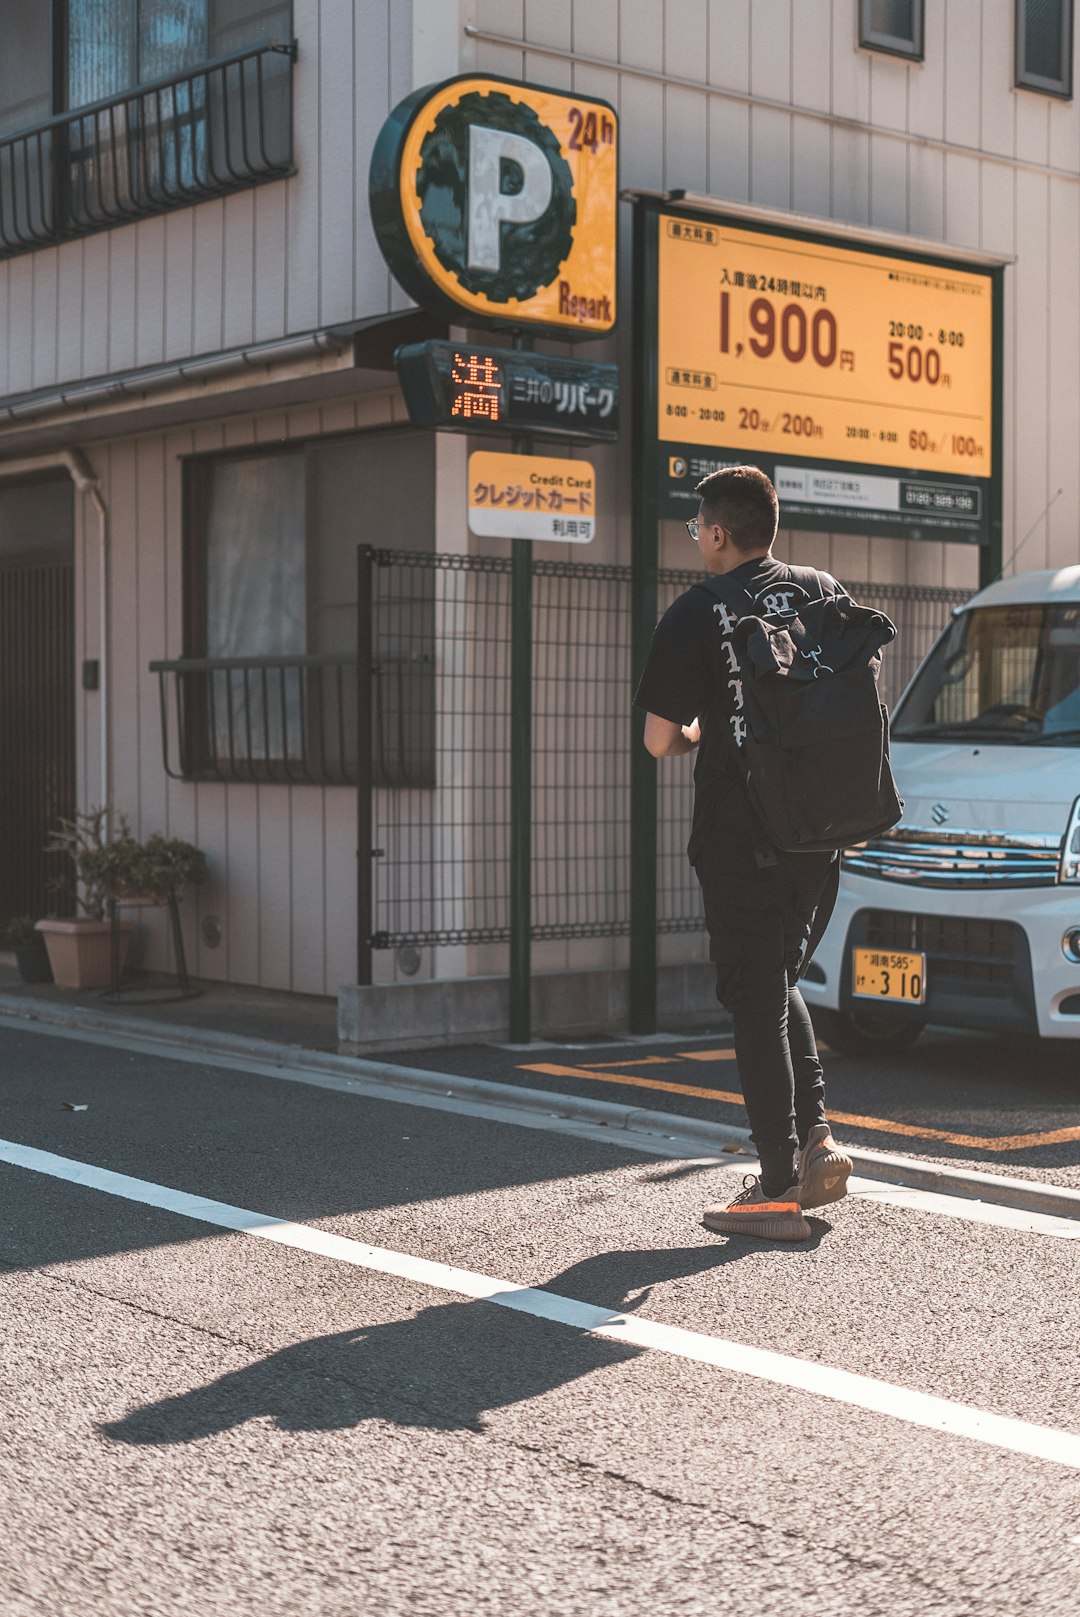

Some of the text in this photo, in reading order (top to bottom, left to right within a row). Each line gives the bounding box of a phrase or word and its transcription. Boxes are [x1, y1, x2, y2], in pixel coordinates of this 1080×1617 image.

[568, 107, 614, 154] 24h
[468, 124, 553, 272] P
[558, 280, 612, 323] Repark
[719, 267, 827, 301] 入庫後24時間以内
[451, 353, 502, 421] 満
[513, 376, 614, 418] 三井のリパーク
[473, 481, 592, 512] クレジットカード
[529, 473, 592, 489] Credit Card
[552, 519, 592, 539] 利用可
